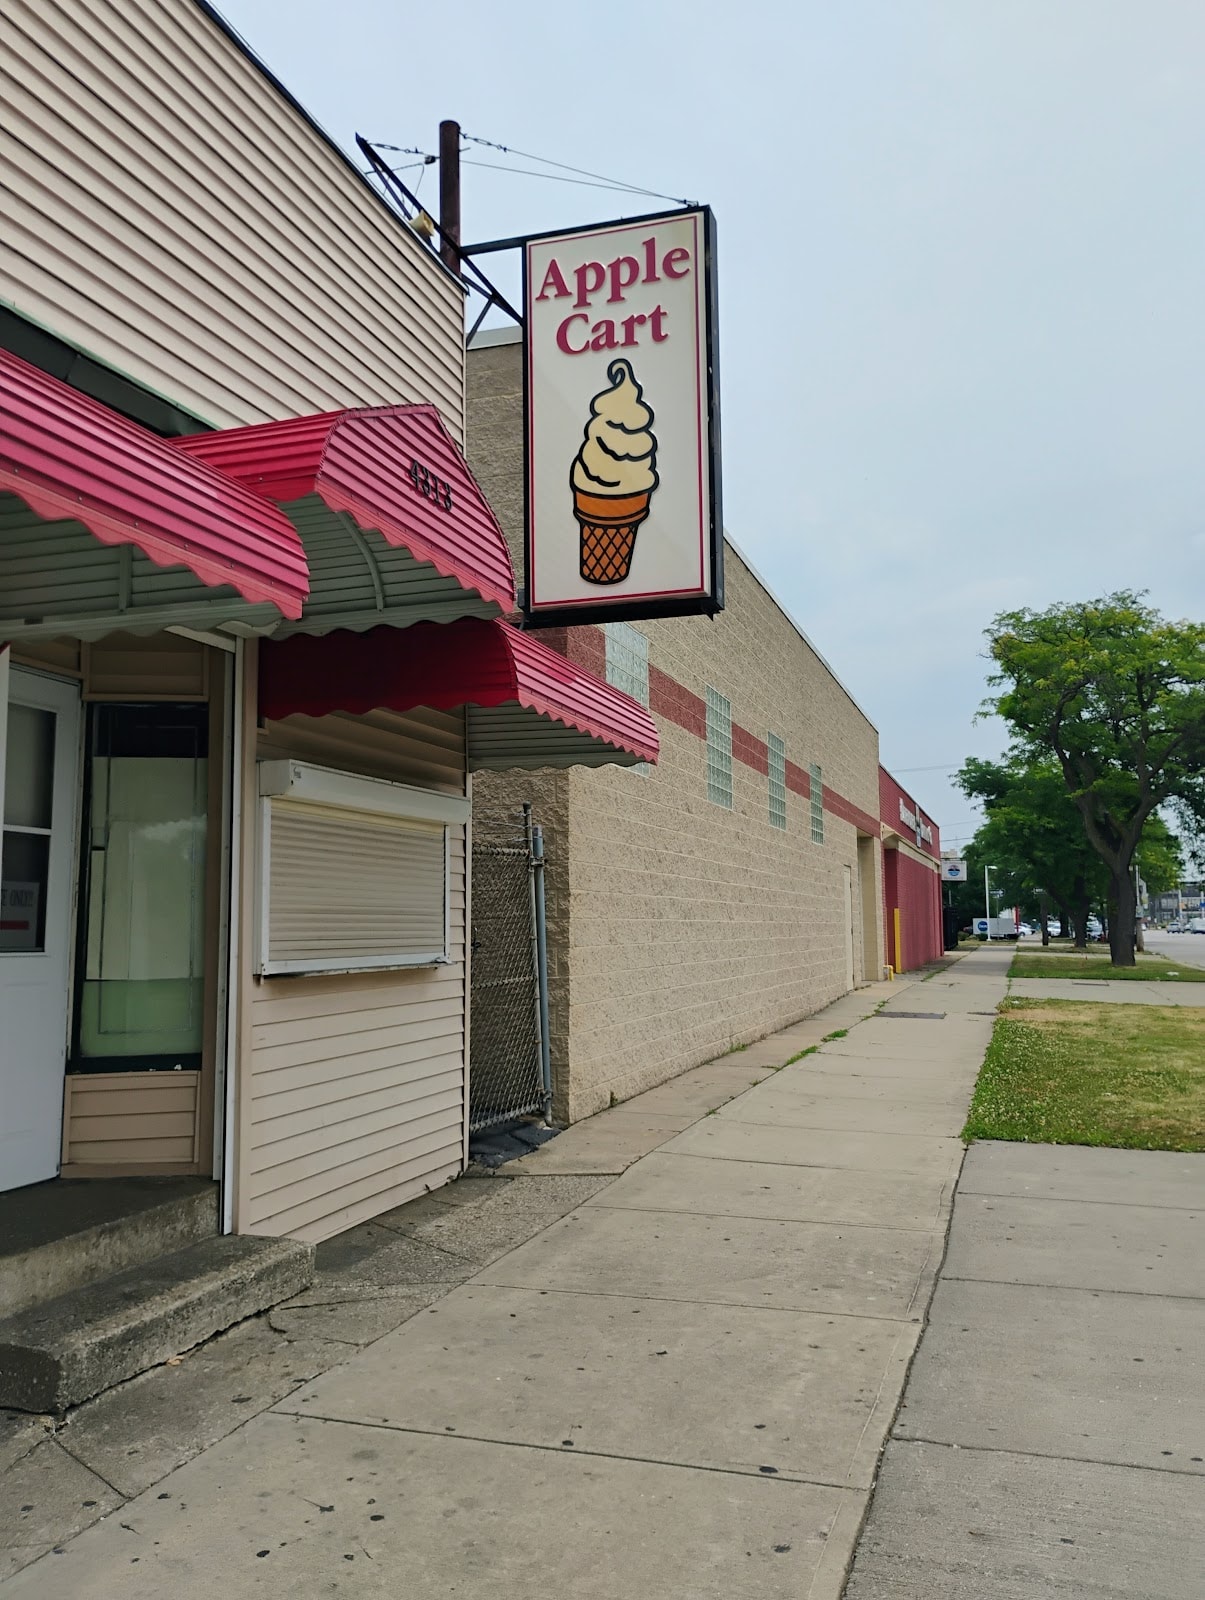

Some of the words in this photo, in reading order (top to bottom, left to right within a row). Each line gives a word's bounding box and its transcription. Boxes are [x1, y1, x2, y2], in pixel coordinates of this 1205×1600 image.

[535, 237, 690, 308] Apple
[556, 304, 668, 355] Cart
[409, 460, 452, 512] 4313
